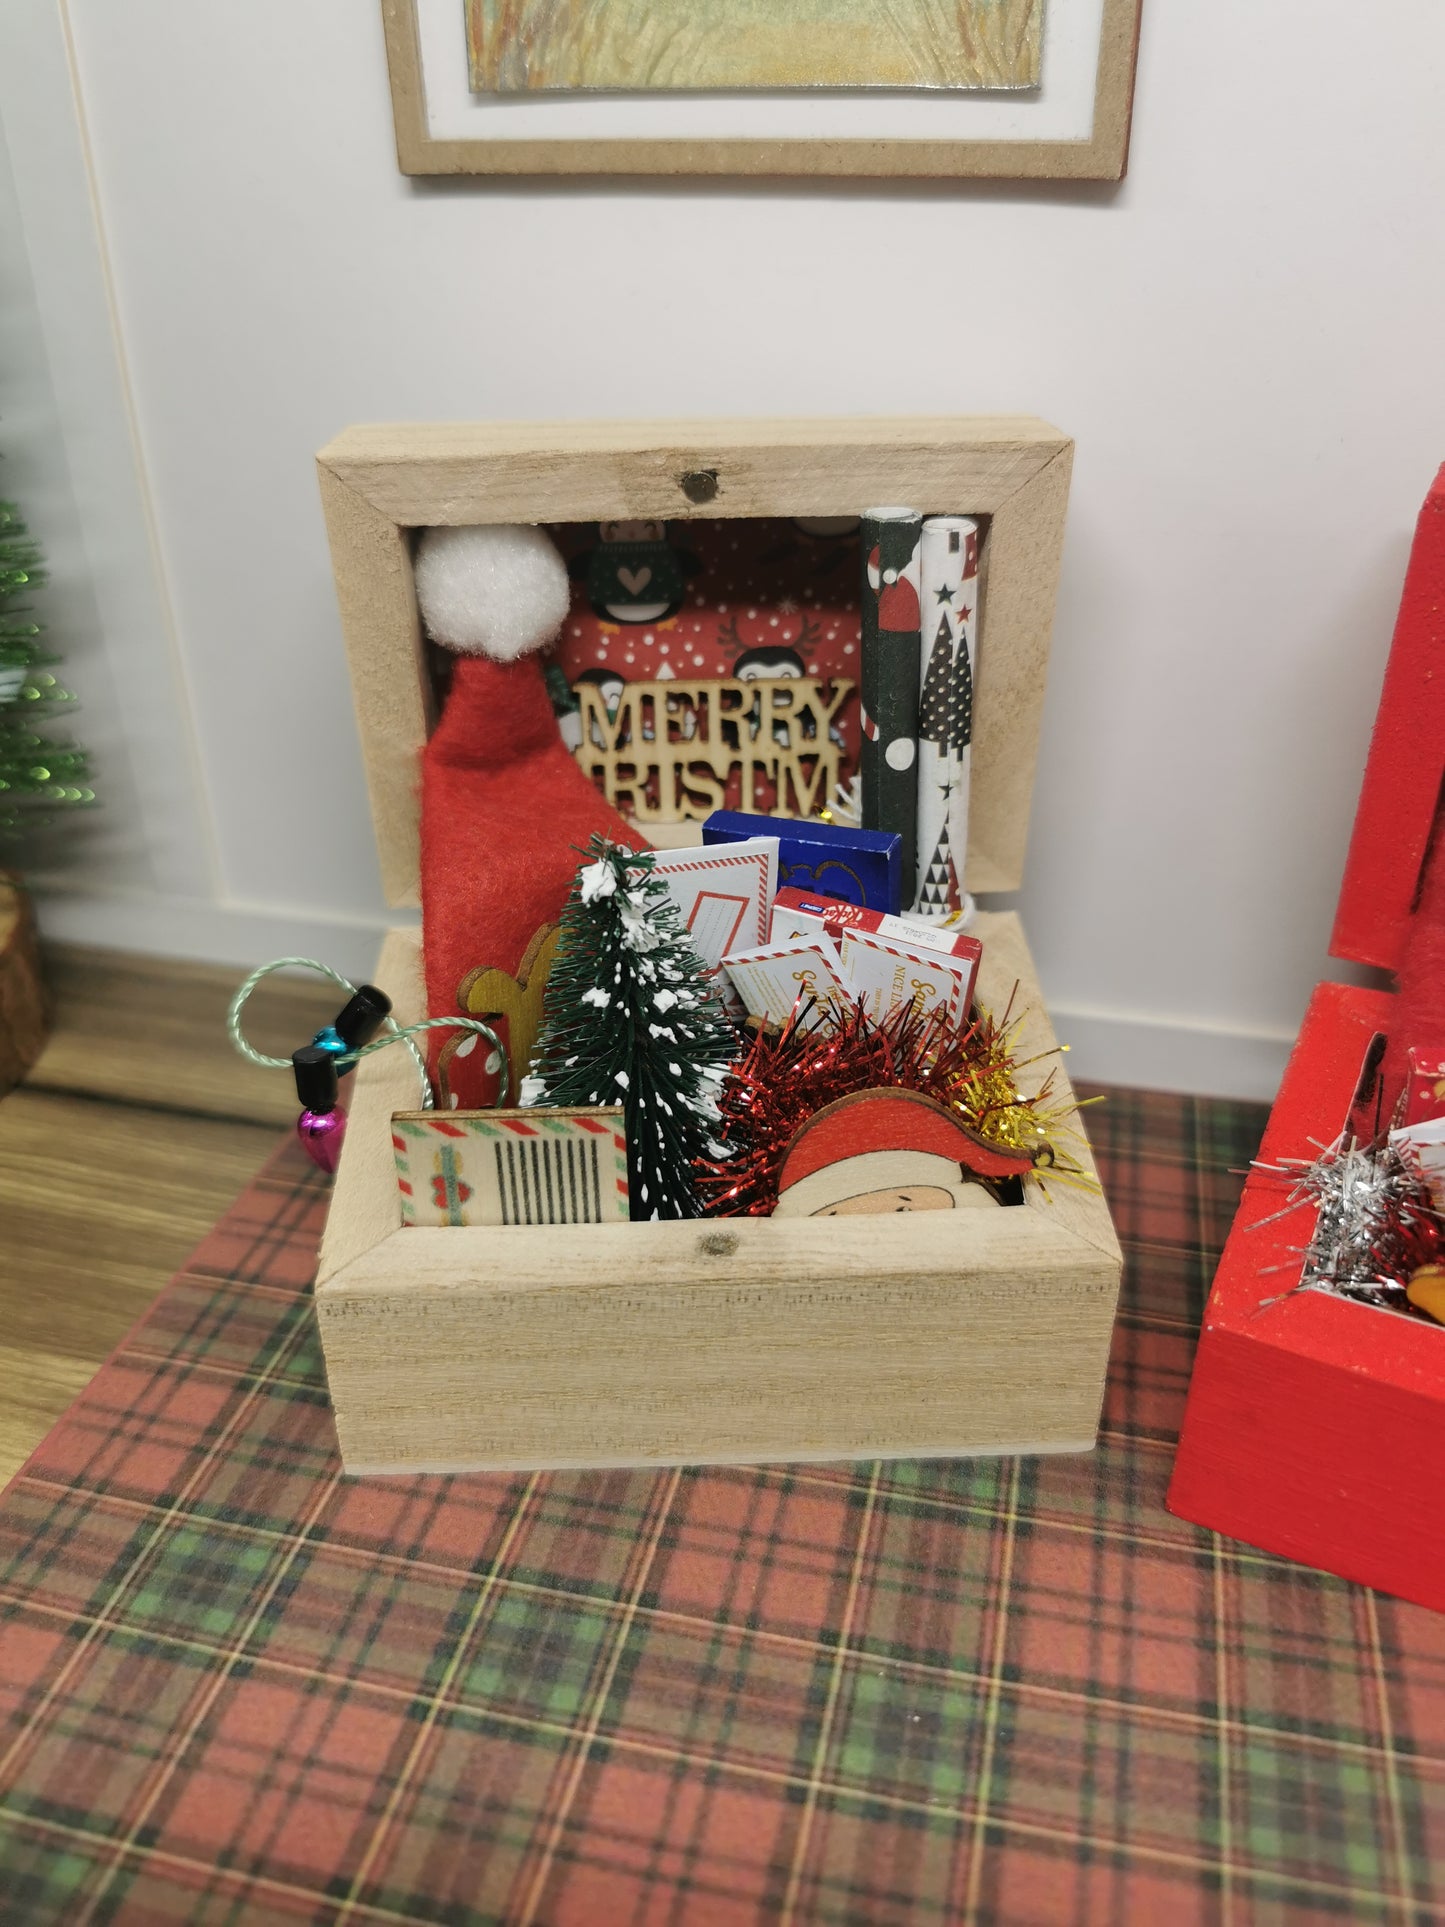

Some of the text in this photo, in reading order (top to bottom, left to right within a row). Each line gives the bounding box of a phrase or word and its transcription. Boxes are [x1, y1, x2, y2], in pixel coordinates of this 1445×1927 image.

[572, 677, 856, 753] MERRY
[578, 752, 846, 823] RISTM
[792, 969, 831, 1017] Santa
[892, 964, 906, 992] NICE
